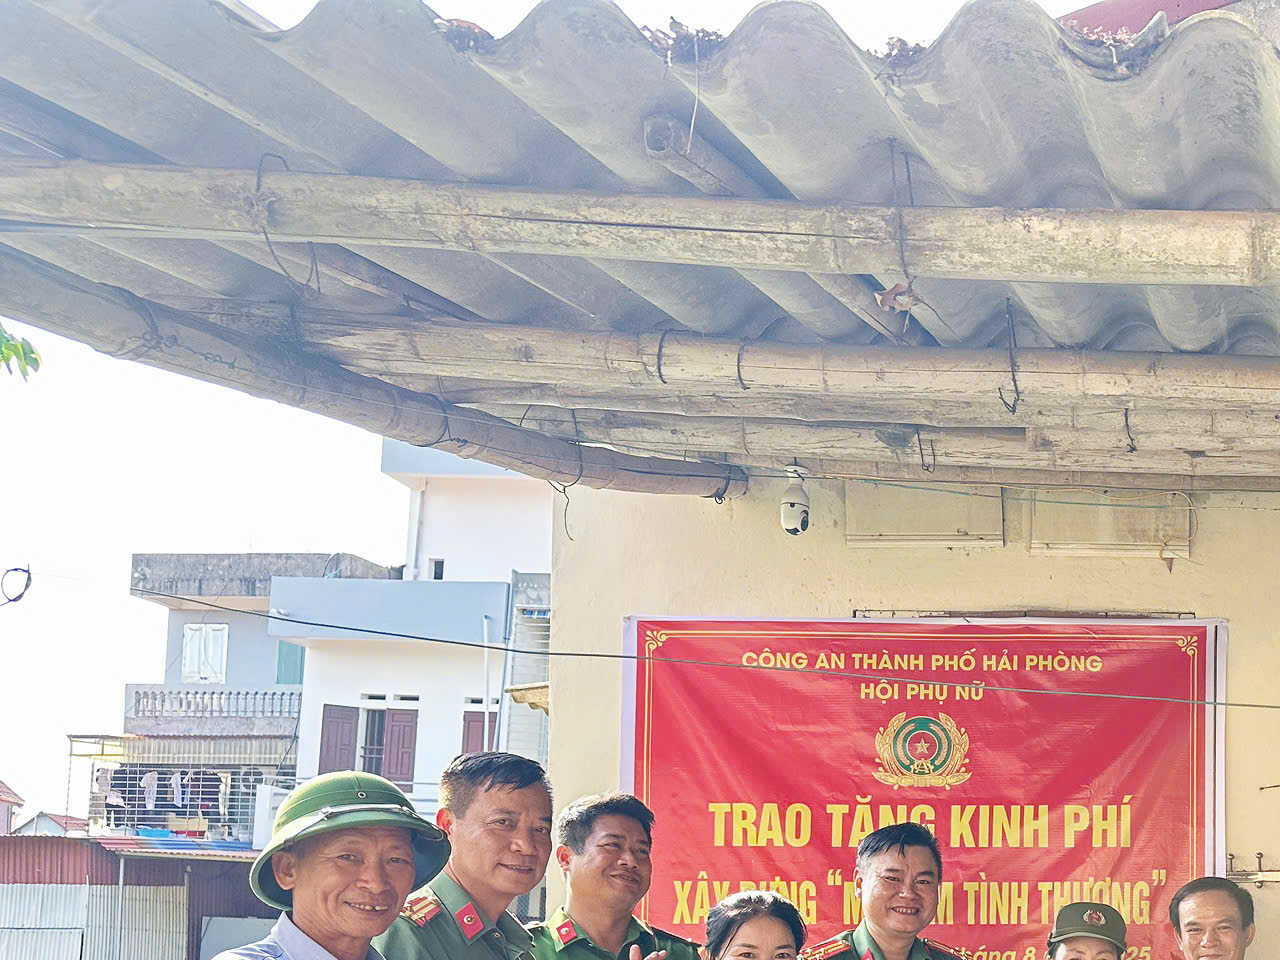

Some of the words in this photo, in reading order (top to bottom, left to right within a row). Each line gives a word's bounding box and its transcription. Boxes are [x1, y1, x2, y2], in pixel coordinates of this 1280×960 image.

[741, 647, 808, 669] CÔNG
[814, 652, 845, 670] AN
[852, 649, 924, 671] THÀNH
[931, 648, 976, 672] PHỐ
[983, 649, 1018, 671] HẢI
[1025, 650, 1103, 672] PHÒNG
[860, 678, 899, 705] HỘI
[906, 683, 948, 705] PHỤ
[709, 802, 812, 848] TRAO
[951, 804, 1049, 848] KINH
[1064, 795, 1132, 848] PHÍ
[963, 872, 1029, 925] TÌNH
